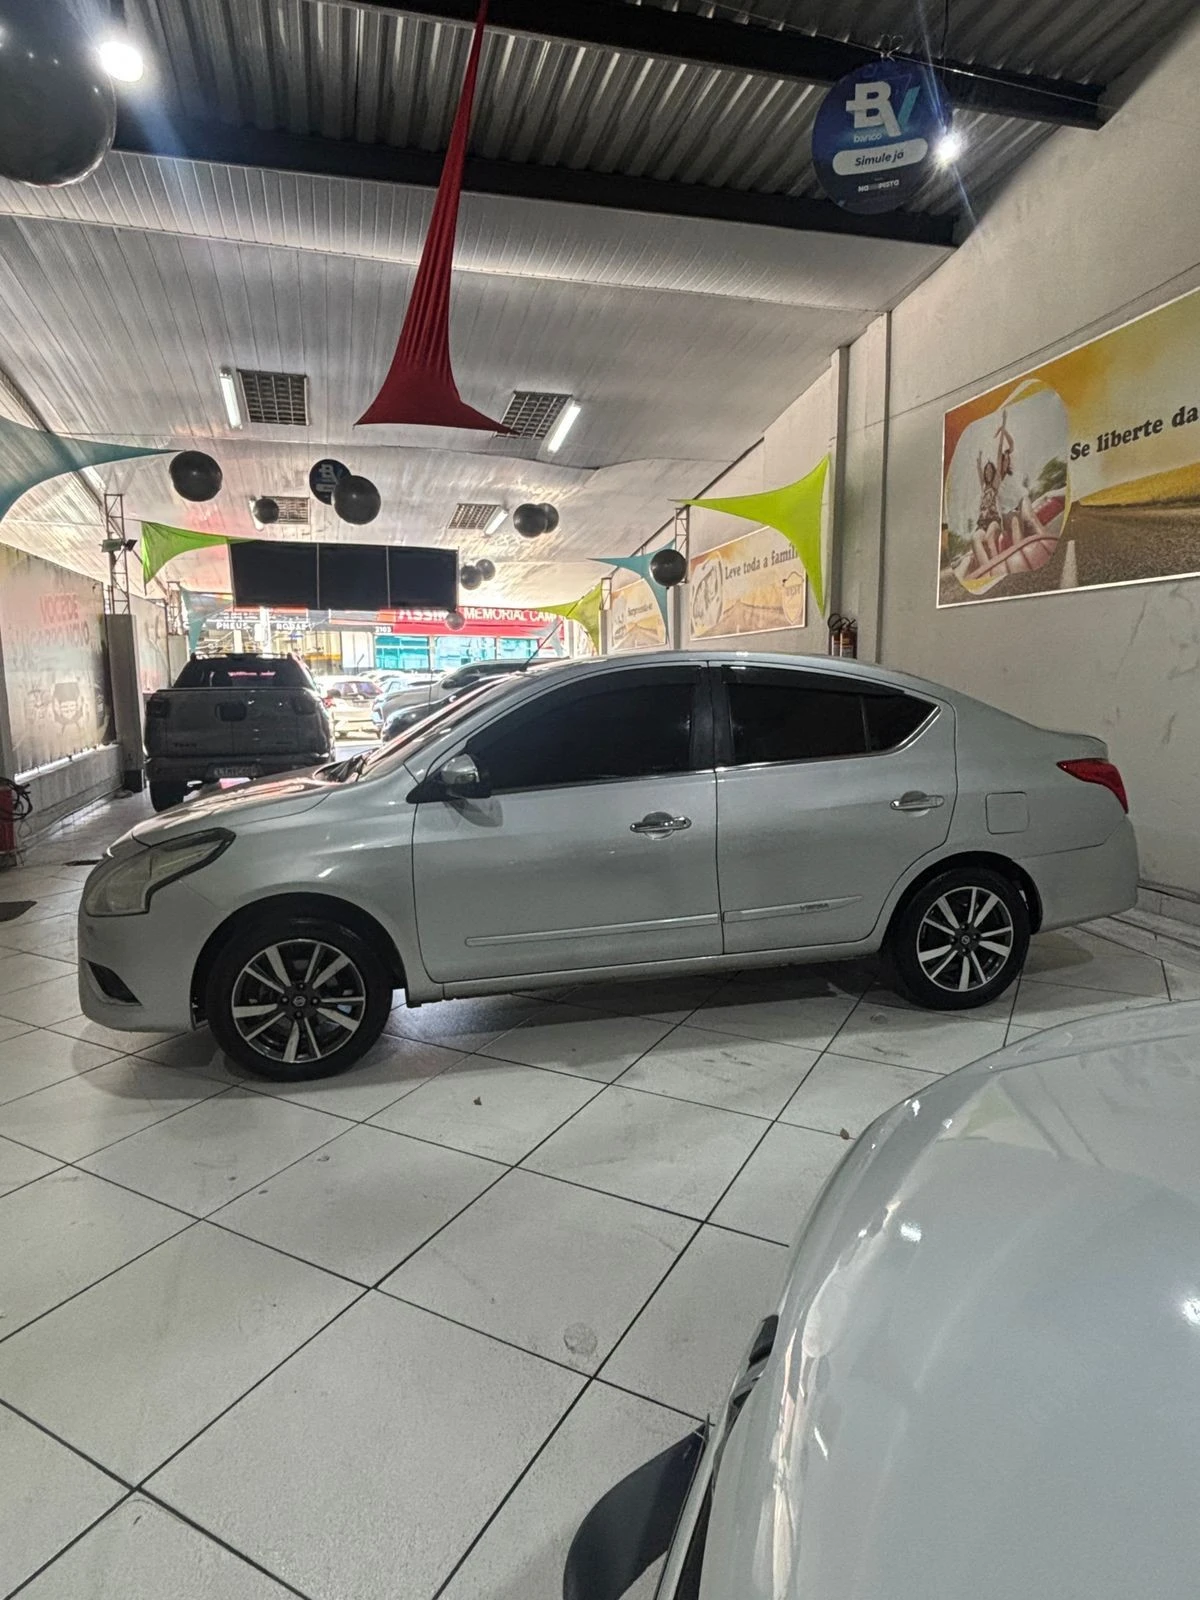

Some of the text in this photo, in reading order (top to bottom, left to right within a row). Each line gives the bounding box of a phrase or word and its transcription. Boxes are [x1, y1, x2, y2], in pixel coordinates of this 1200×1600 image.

[854, 133, 882, 143] banco
[855, 152, 892, 166] Simule
[1070, 406, 1199, 460] Se liberte da
[725, 543, 799, 580] Leve toda a famíli
[464, 607, 527, 621] MEMORIAL
